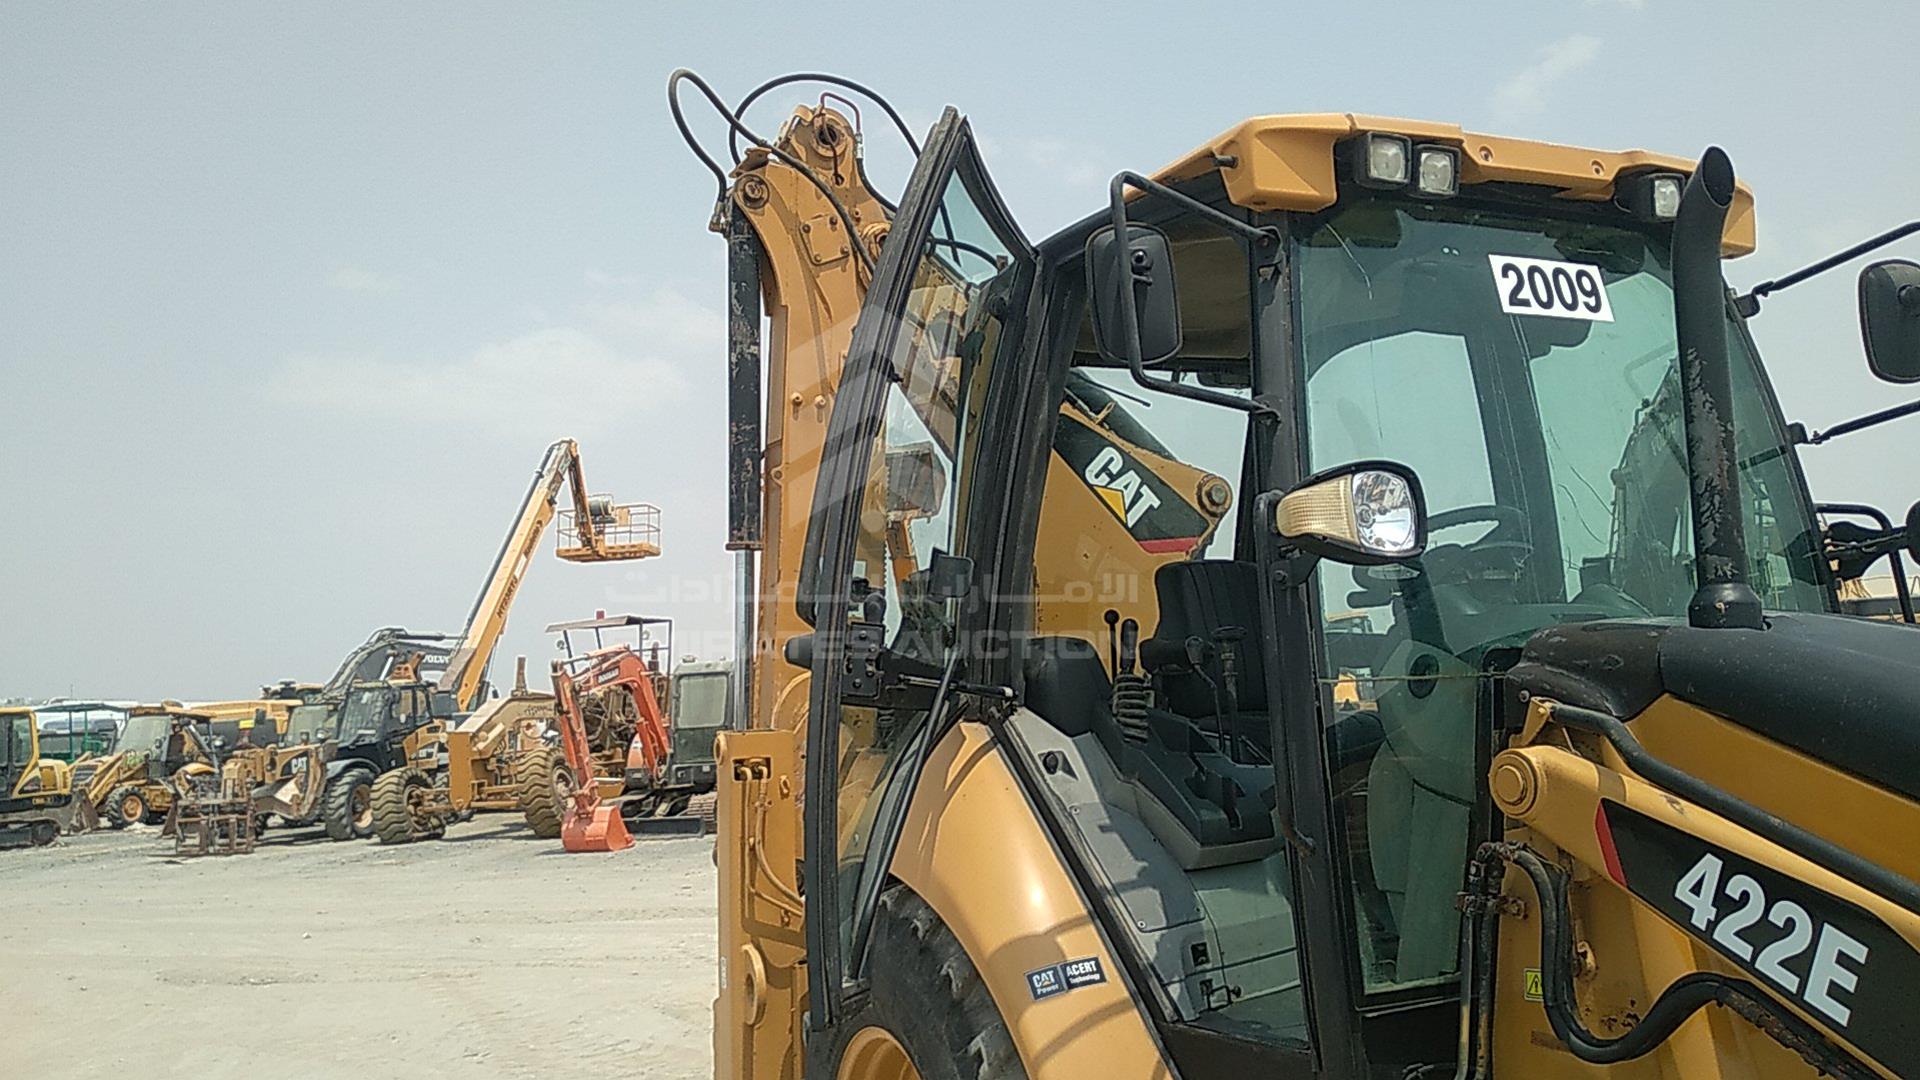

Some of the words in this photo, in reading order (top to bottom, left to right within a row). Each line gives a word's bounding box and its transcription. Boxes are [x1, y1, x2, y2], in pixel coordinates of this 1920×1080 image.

[1501, 262, 1602, 314] 2009
[1085, 446, 1161, 529] CAT
[291, 756, 308, 775] CAT
[1674, 852, 1869, 1028] 422E
[1066, 960, 1098, 977] ACERT
[1032, 970, 1055, 988] CAT
[1037, 983, 1060, 995] Power
